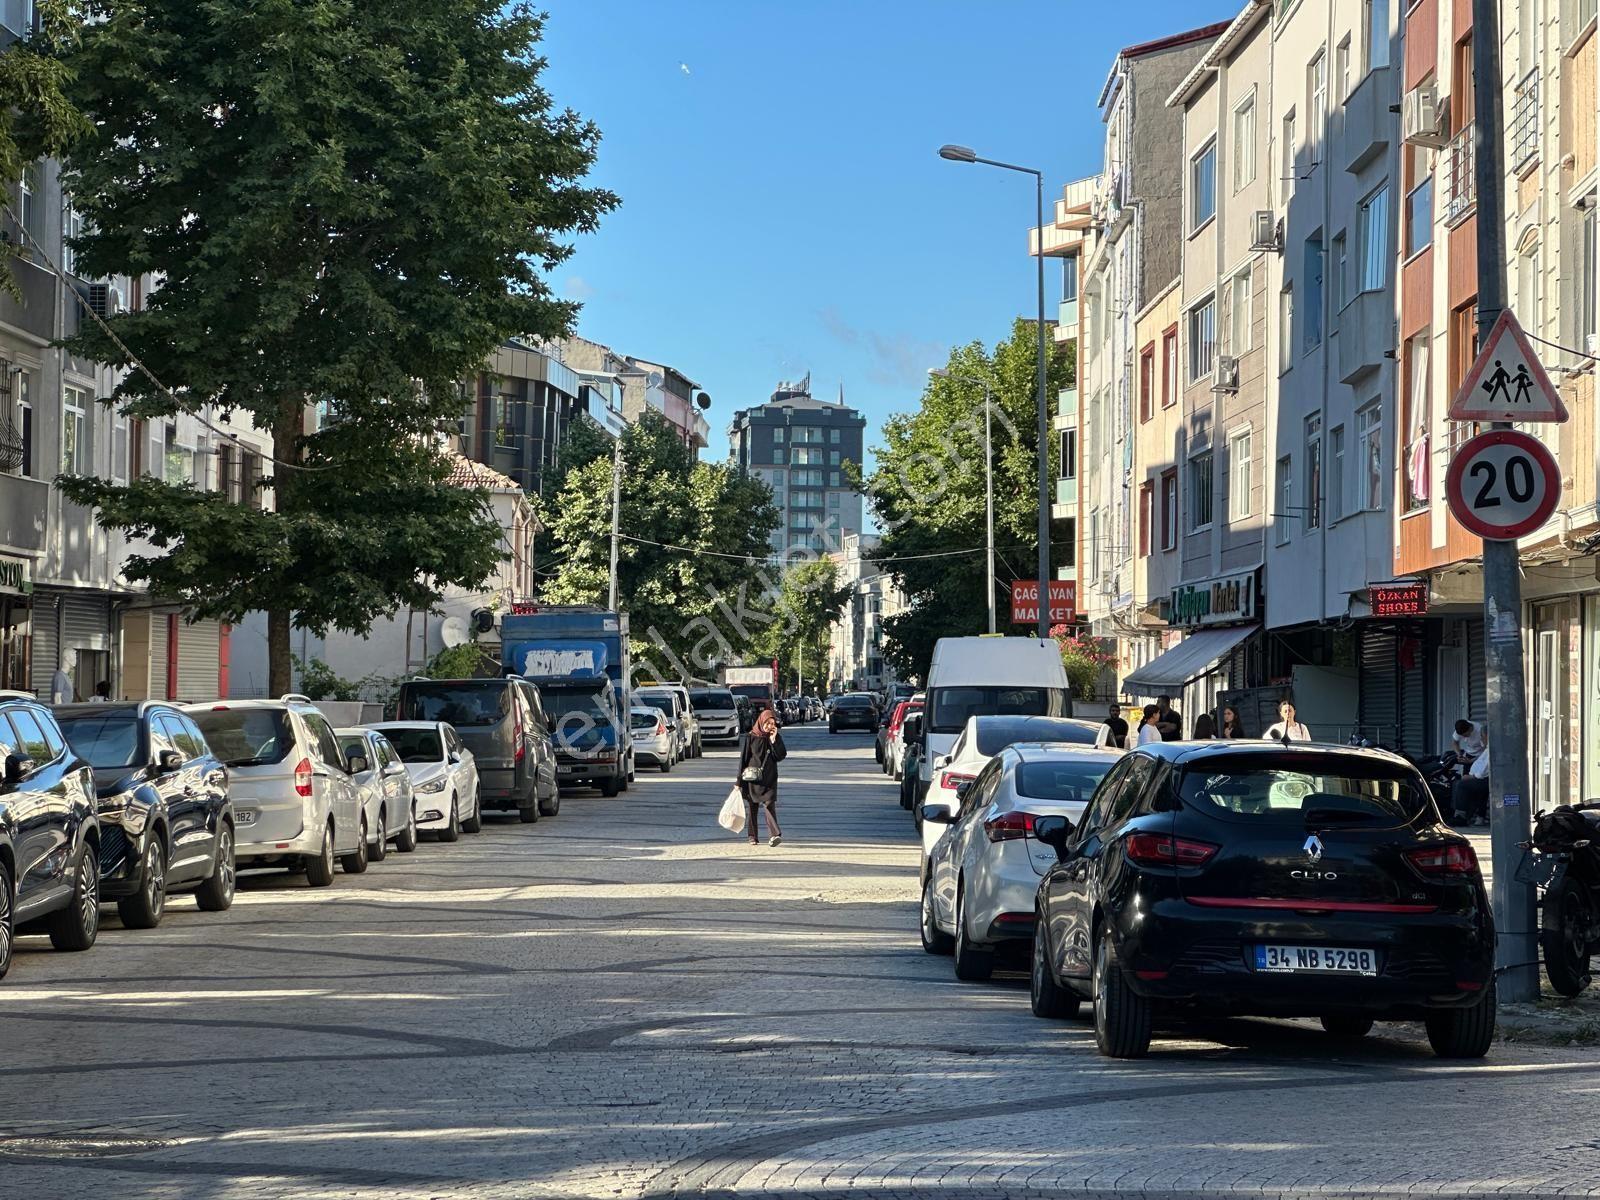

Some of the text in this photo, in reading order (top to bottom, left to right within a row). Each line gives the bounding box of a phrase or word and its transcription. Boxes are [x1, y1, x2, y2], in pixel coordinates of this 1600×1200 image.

[1470, 455, 1535, 509] 20
[1014, 584, 1074, 604] ÇAĞAYAN
[1377, 590, 1418, 601] ÖZKAN
[1378, 602, 1418, 612] SHOES
[1290, 870, 1338, 880] CLIO
[1267, 947, 1290, 967] 34
[1296, 948, 1320, 968] NB
[1324, 949, 1370, 970] 5298
